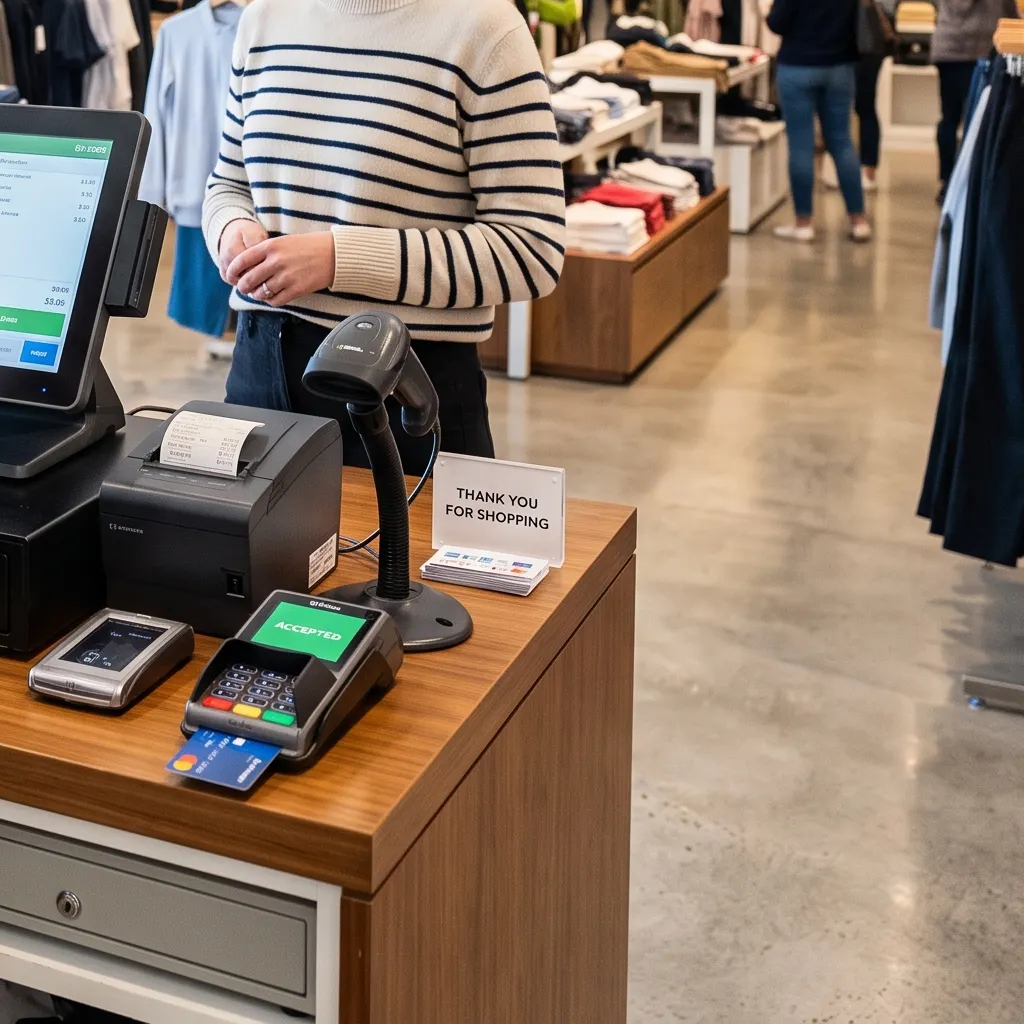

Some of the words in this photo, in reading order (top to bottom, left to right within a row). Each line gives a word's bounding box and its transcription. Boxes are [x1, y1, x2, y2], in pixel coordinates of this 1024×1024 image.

[456, 487, 505, 505] THANK
[508, 494, 538, 509] YOU
[445, 504, 474, 519] FOR
[477, 509, 549, 530] SHOPPING
[274, 621, 342, 641] ACCEPTED
